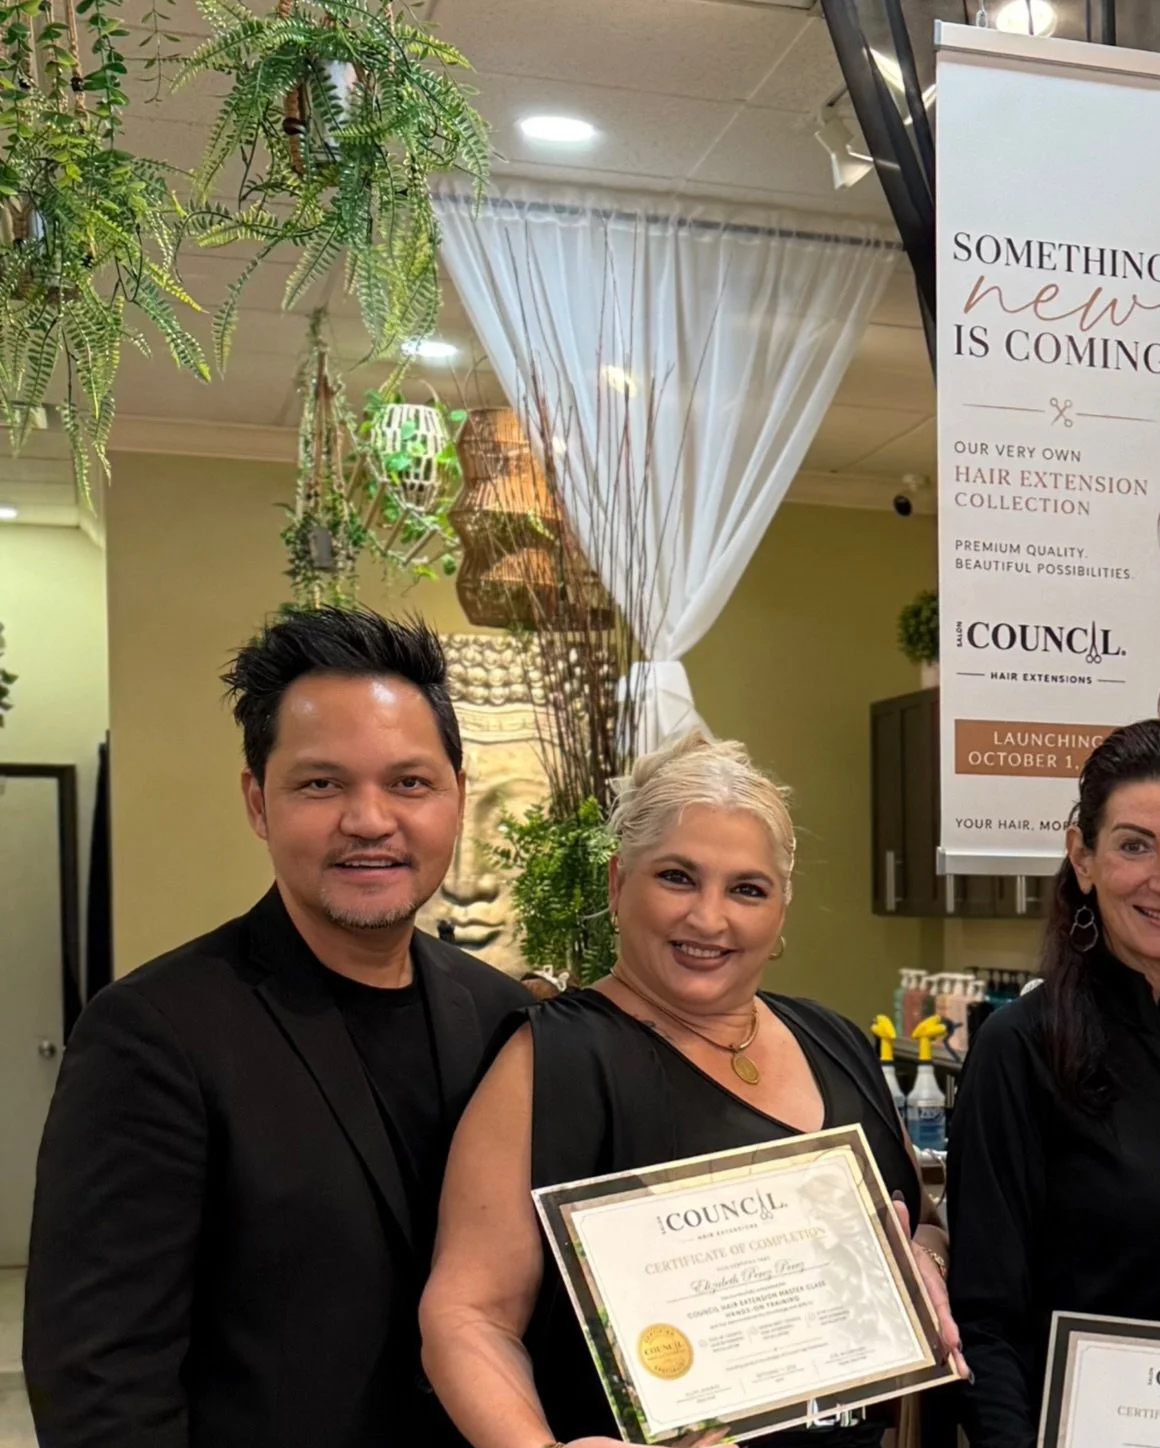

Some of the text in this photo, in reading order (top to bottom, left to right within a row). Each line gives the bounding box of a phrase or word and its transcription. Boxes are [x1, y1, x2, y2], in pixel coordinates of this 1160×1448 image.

[953, 324, 989, 357] IS
[954, 441, 1081, 462] OUR VERY OWN
[955, 465, 1149, 496] HAIR EXTENSION
[954, 492, 1091, 516] COLLECTION
[955, 540, 1088, 559] PREMIUM QUALITY.
[955, 558, 1134, 579] BEAUTIFUL POSSIBILITIES.
[990, 671, 1093, 685] HAIR EXTENSIONS
[968, 751, 1057, 768] OCTOBER
[955, 818, 993, 830] YOUR
[644, 1249, 727, 1276] CERTIFICATE
[729, 1241, 747, 1256] OF
[749, 1226, 826, 1252] COMPLETION
[778, 1285, 804, 1297] MASTER
